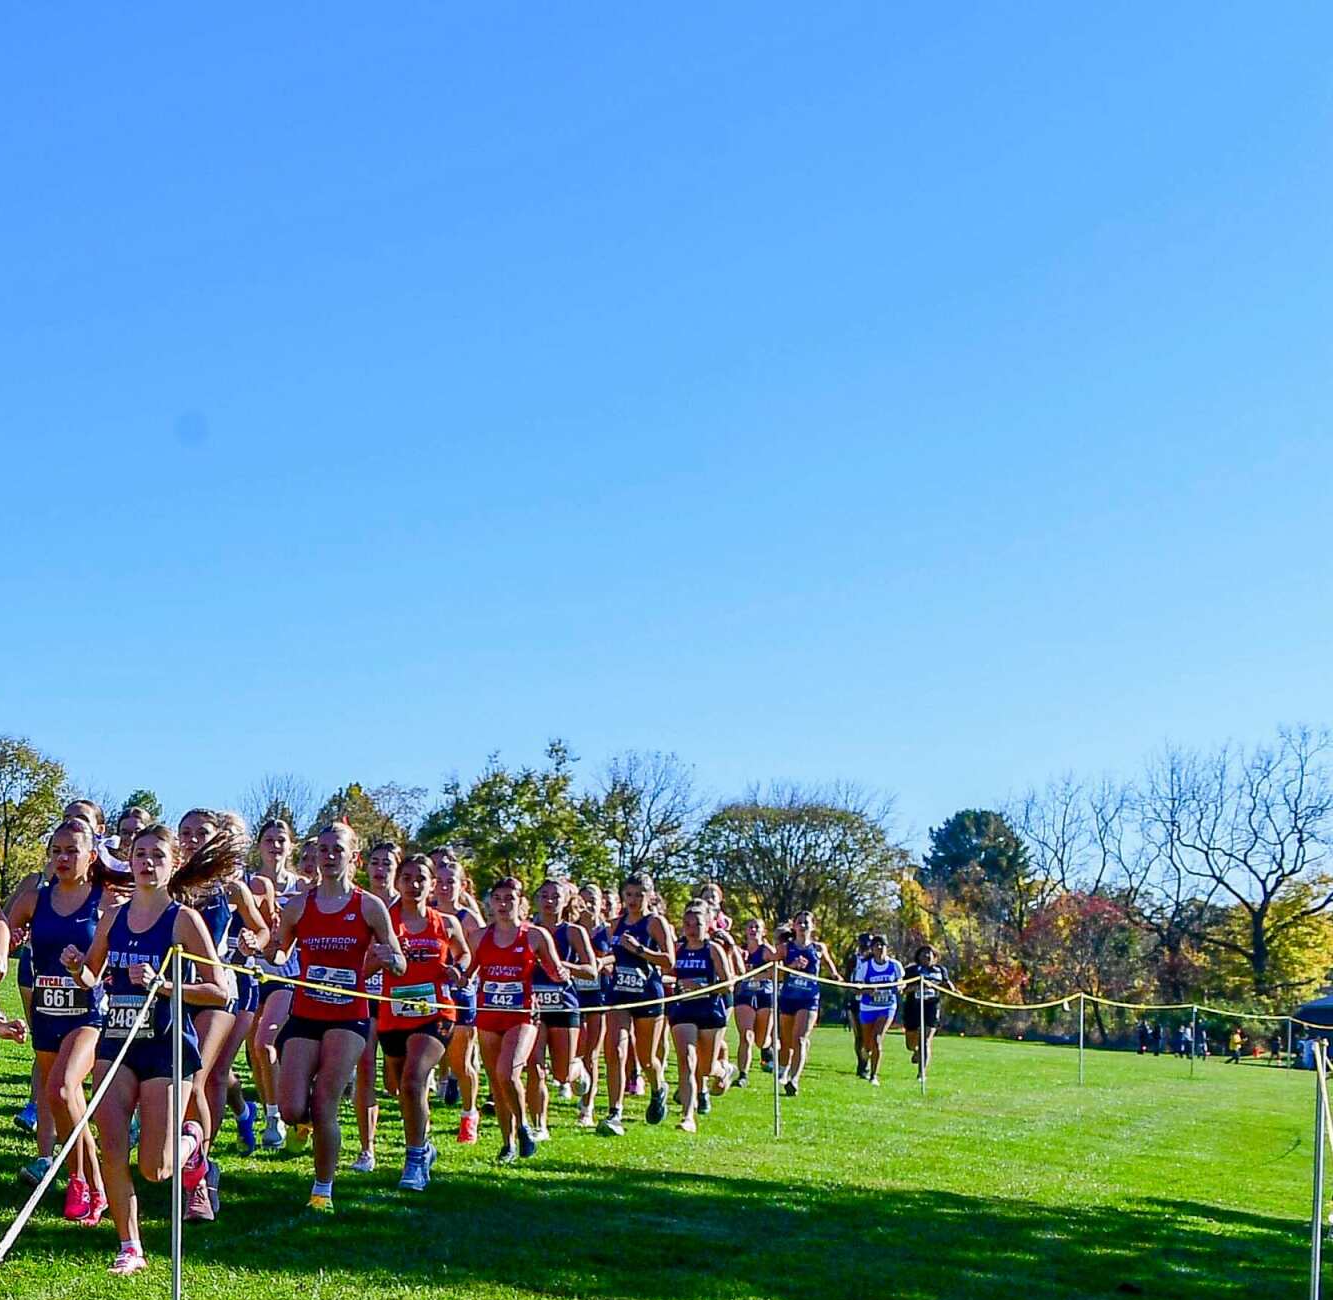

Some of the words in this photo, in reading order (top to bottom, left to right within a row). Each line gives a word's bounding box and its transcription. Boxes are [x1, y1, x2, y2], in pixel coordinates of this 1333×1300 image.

[616, 974, 644, 987] 3494
[43, 989, 74, 1007] 661
[491, 994, 514, 1005] 442
